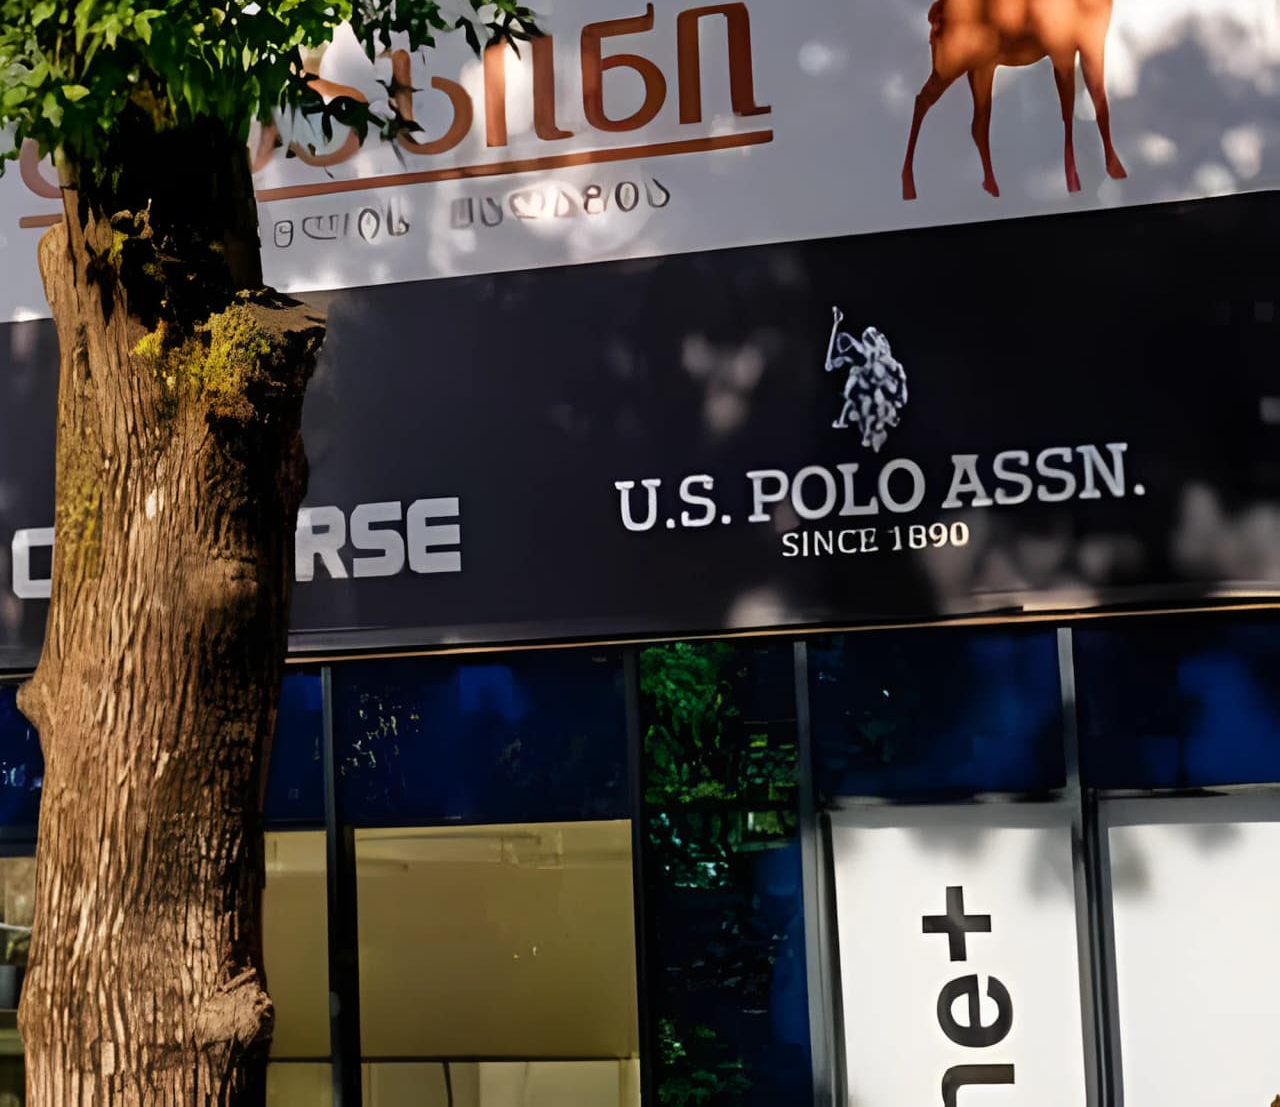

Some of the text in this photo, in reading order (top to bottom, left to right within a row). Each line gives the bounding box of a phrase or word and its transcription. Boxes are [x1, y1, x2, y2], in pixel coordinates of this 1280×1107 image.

[614, 442, 1146, 532] U.S. POLO ASSN.
[781, 521, 970, 557] SINCE 1890
